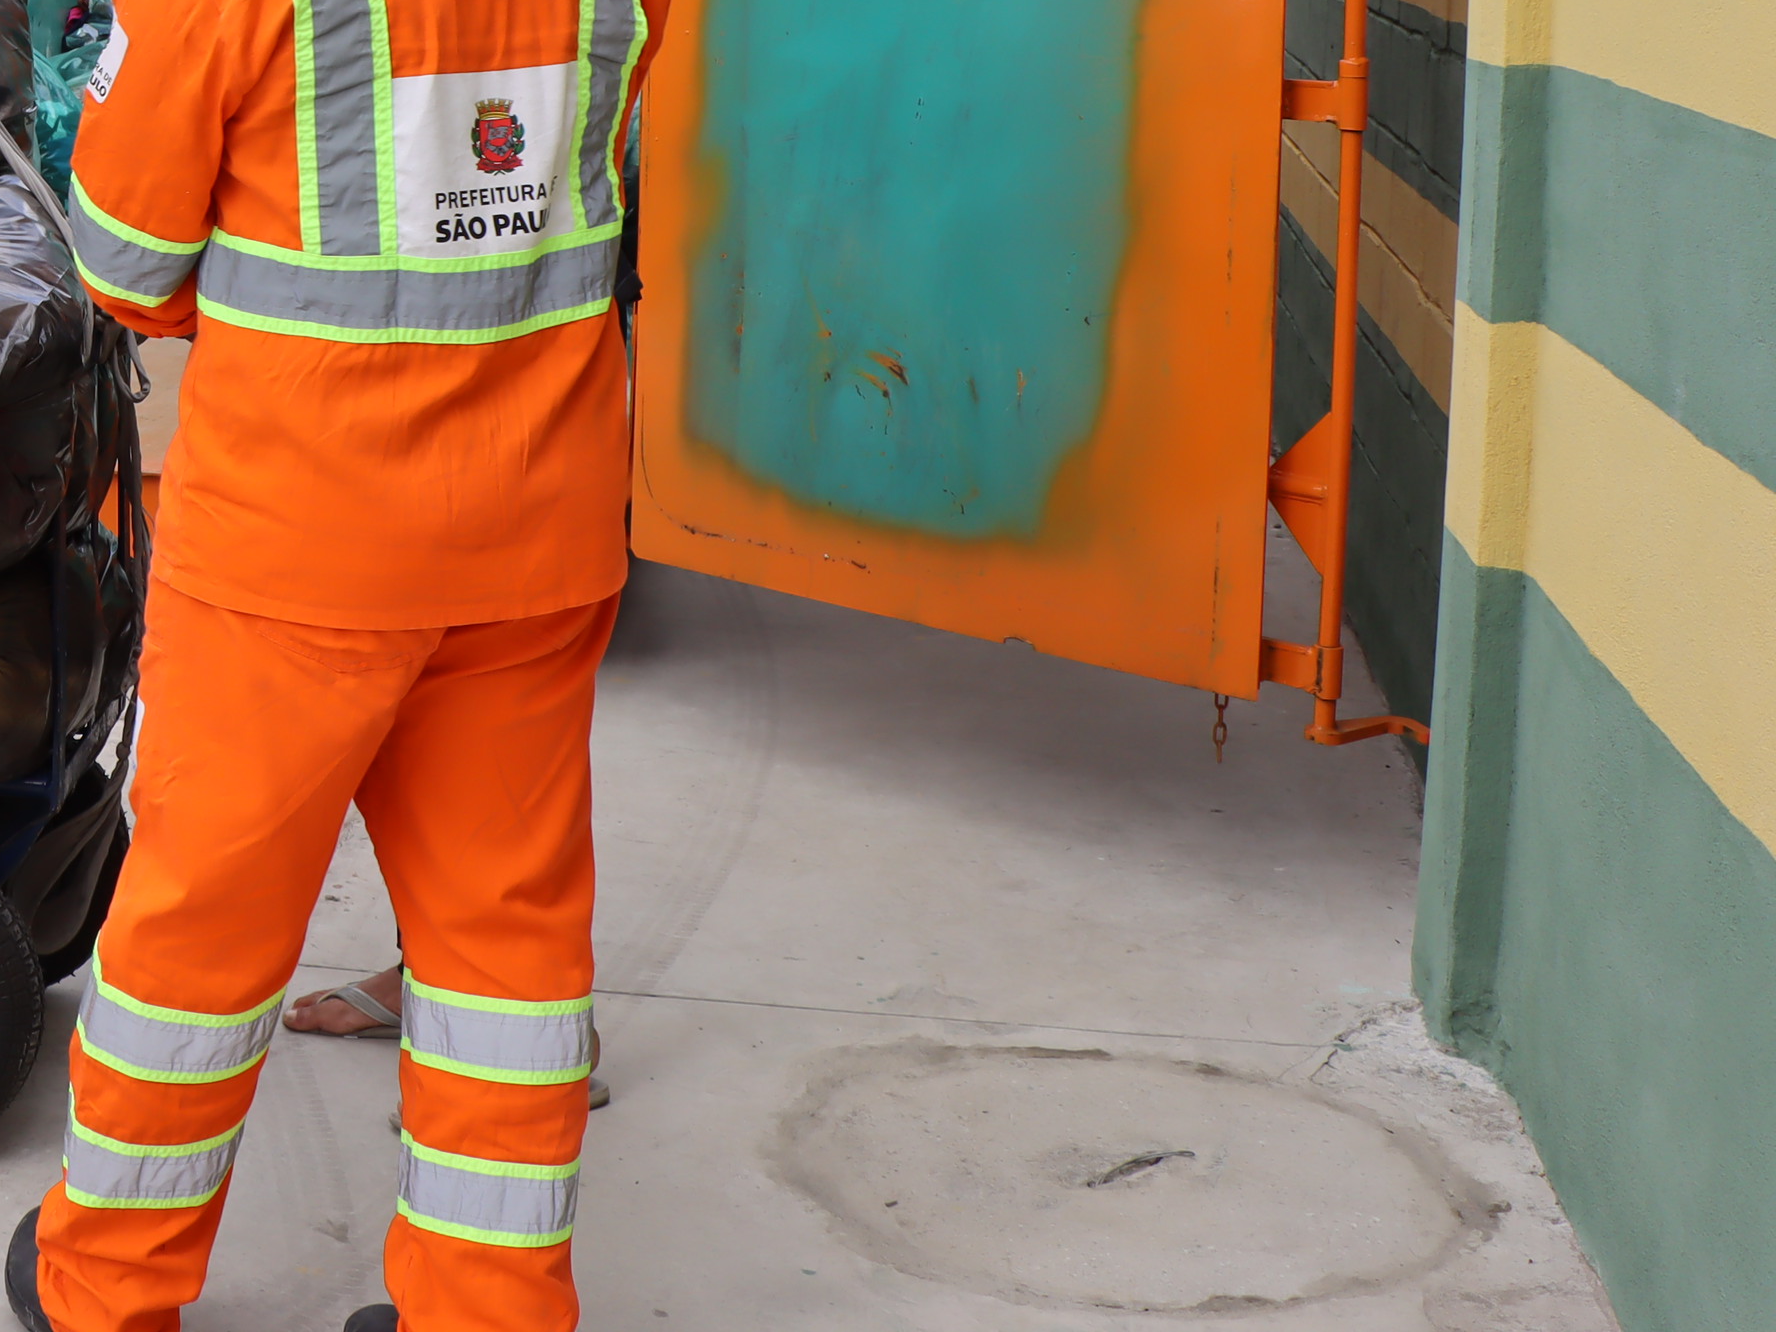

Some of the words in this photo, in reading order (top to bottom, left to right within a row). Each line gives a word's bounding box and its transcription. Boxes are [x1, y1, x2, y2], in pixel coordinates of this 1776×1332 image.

[89, 73, 107, 97] ULO
[435, 182, 548, 210] PREFEITURA
[435, 213, 488, 244] SÃO
[492, 208, 549, 237] PAU
